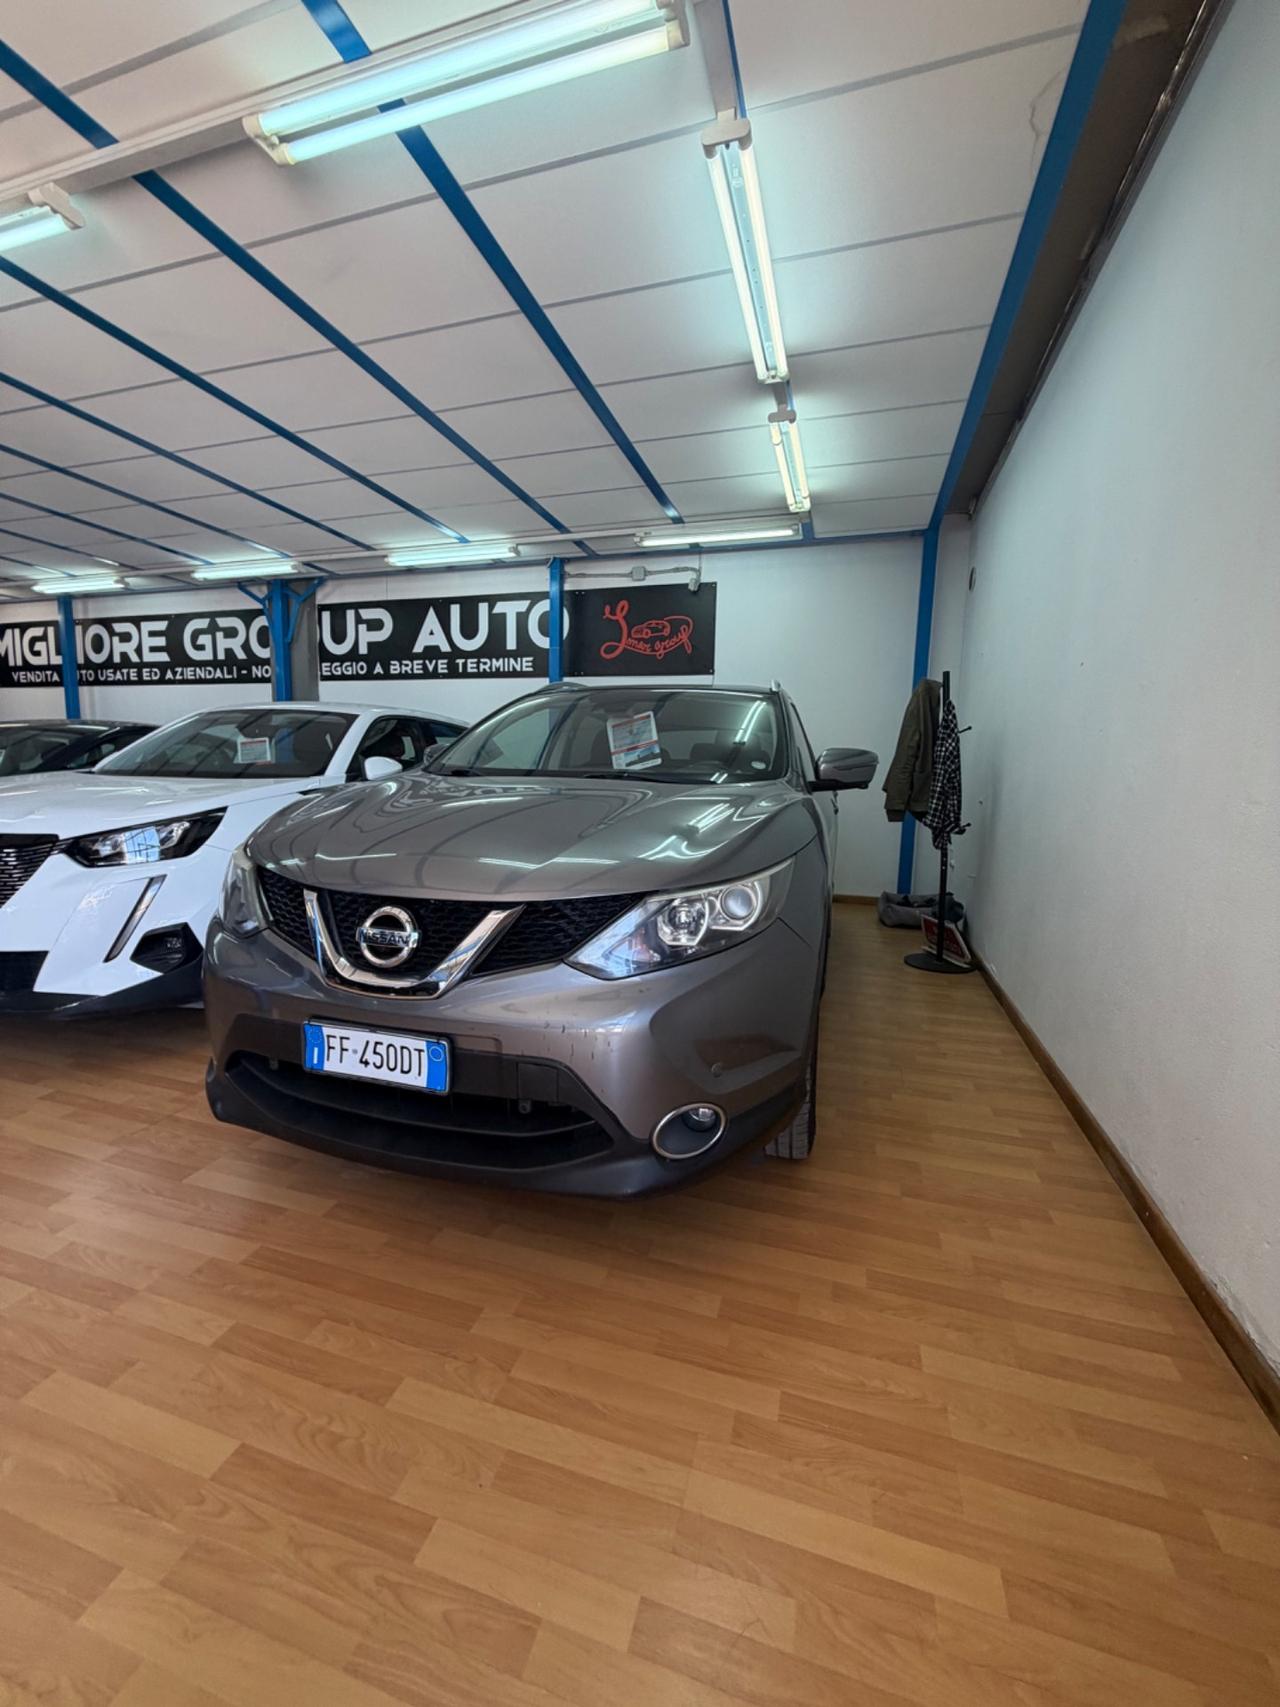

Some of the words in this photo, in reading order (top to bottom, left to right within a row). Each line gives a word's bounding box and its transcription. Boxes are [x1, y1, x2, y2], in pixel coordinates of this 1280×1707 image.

[412, 598, 570, 653] AUTO
[11, 670, 60, 683] VENDITA
[97, 668, 138, 681] USATE
[142, 667, 161, 680] ED
[165, 666, 237, 680] AZIENDALI
[373, 661, 384, 675] A
[390, 660, 449, 674] BREVE
[456, 656, 534, 674] TERMINE
[359, 928, 411, 945] NISSAN
